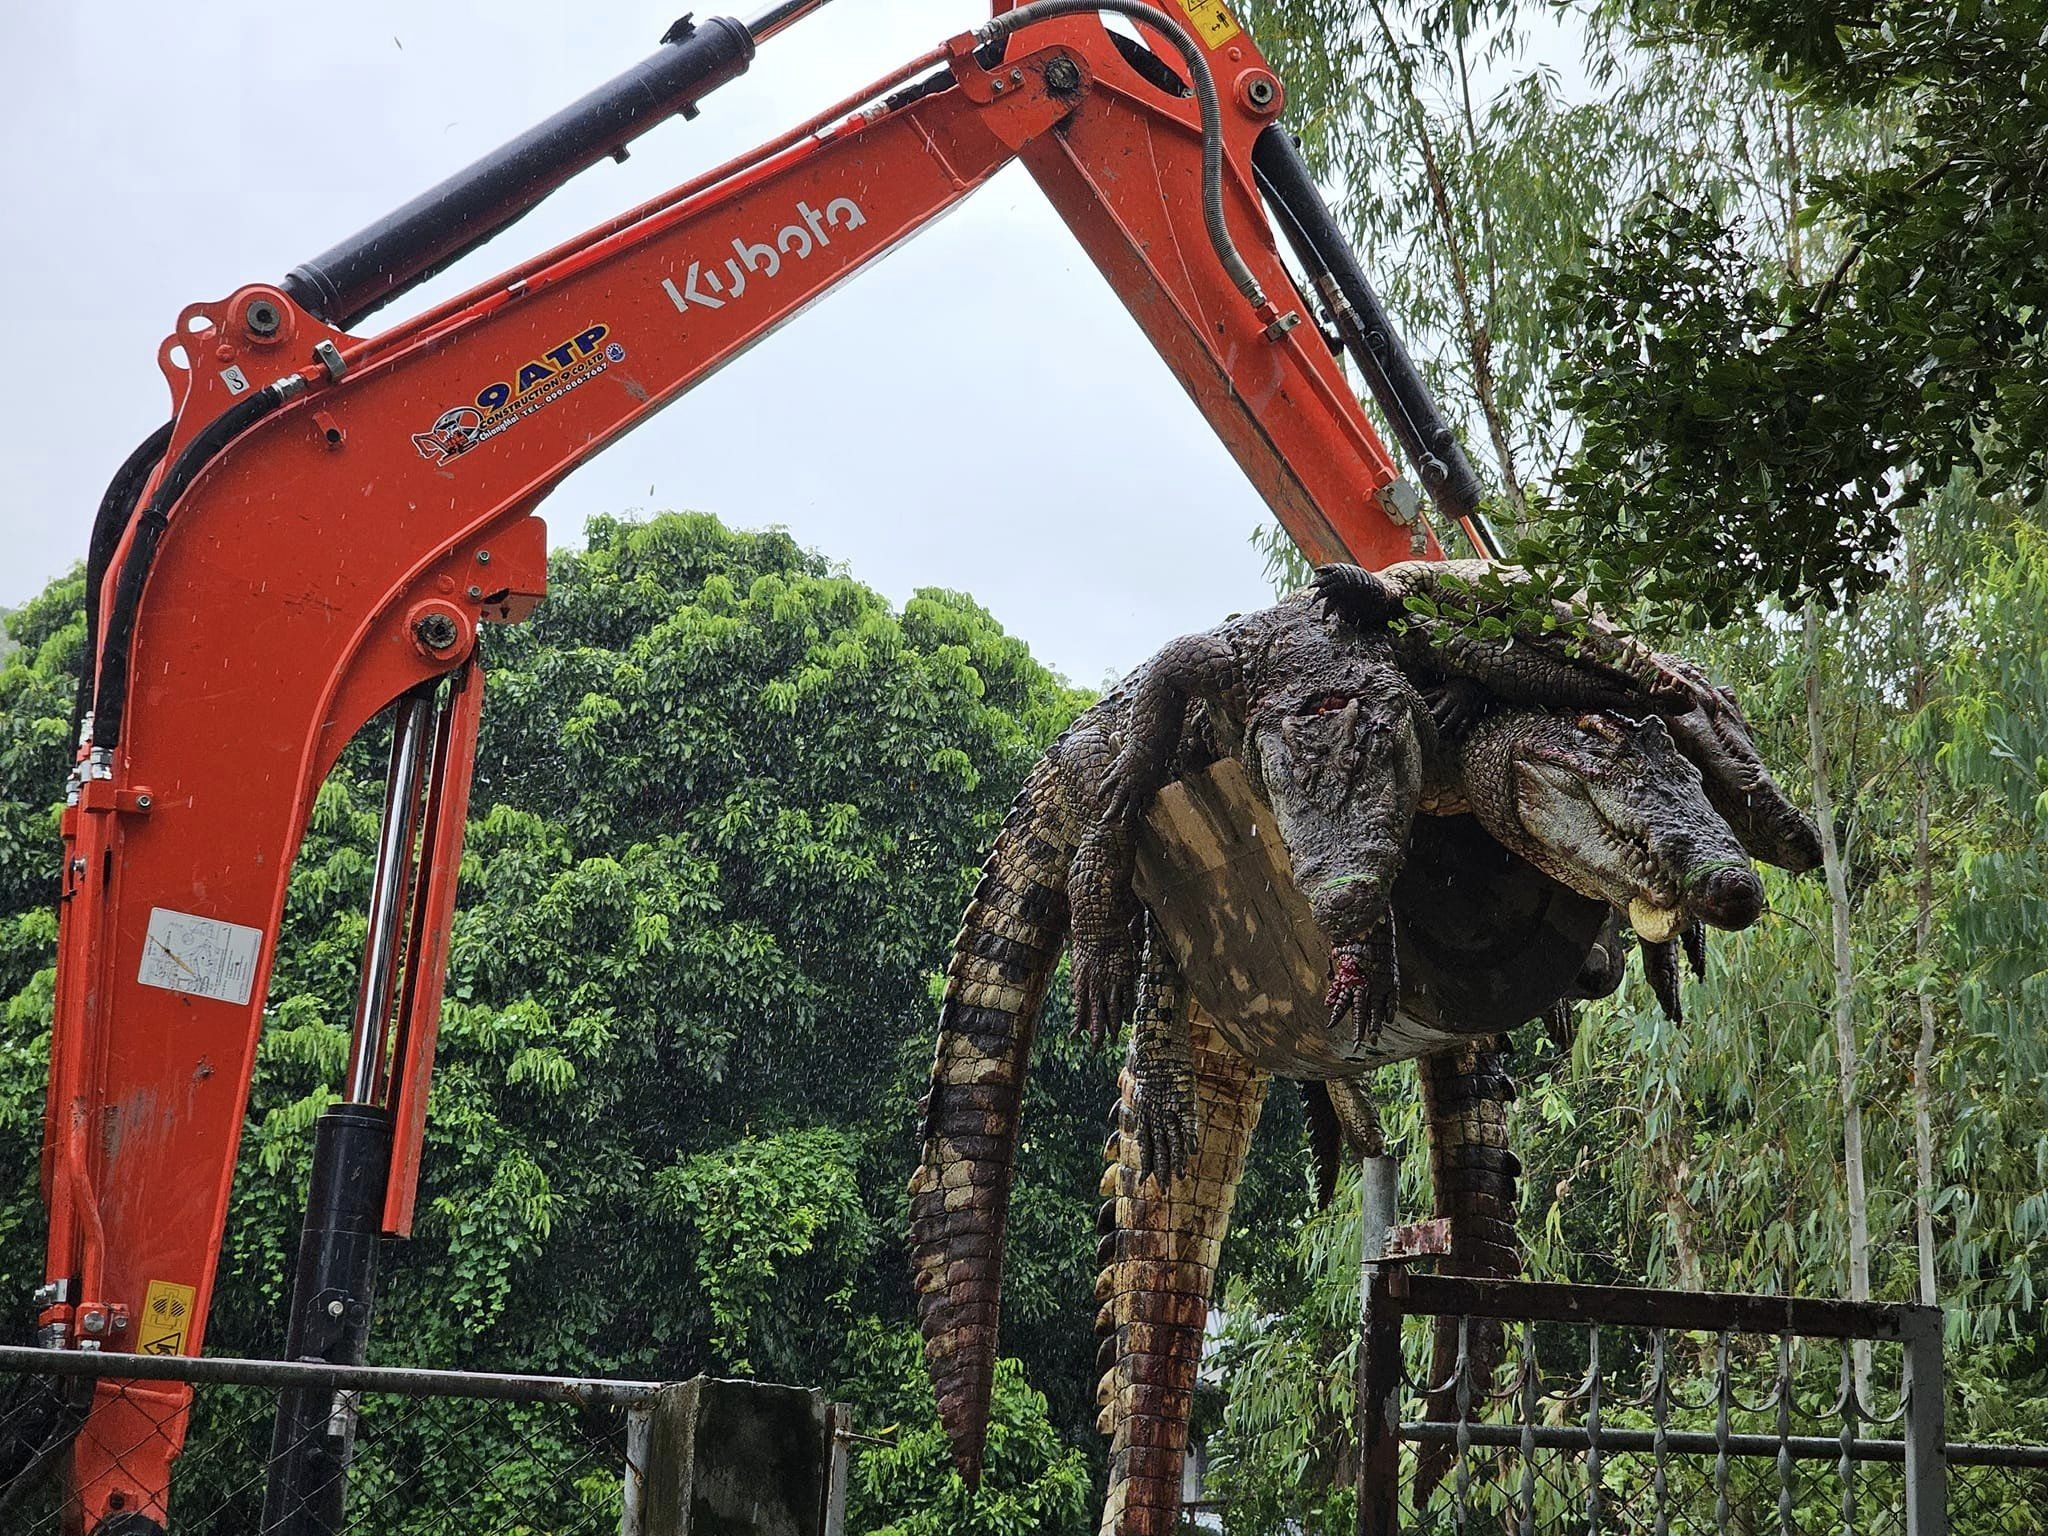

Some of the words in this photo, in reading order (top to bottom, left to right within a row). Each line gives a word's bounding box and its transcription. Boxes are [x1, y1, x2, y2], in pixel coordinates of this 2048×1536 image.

[661, 198, 867, 313] Kubota
[517, 324, 609, 395] ATP
[479, 377, 560, 429] CONSTRUCTION
[479, 413, 519, 440] ChiangMai
